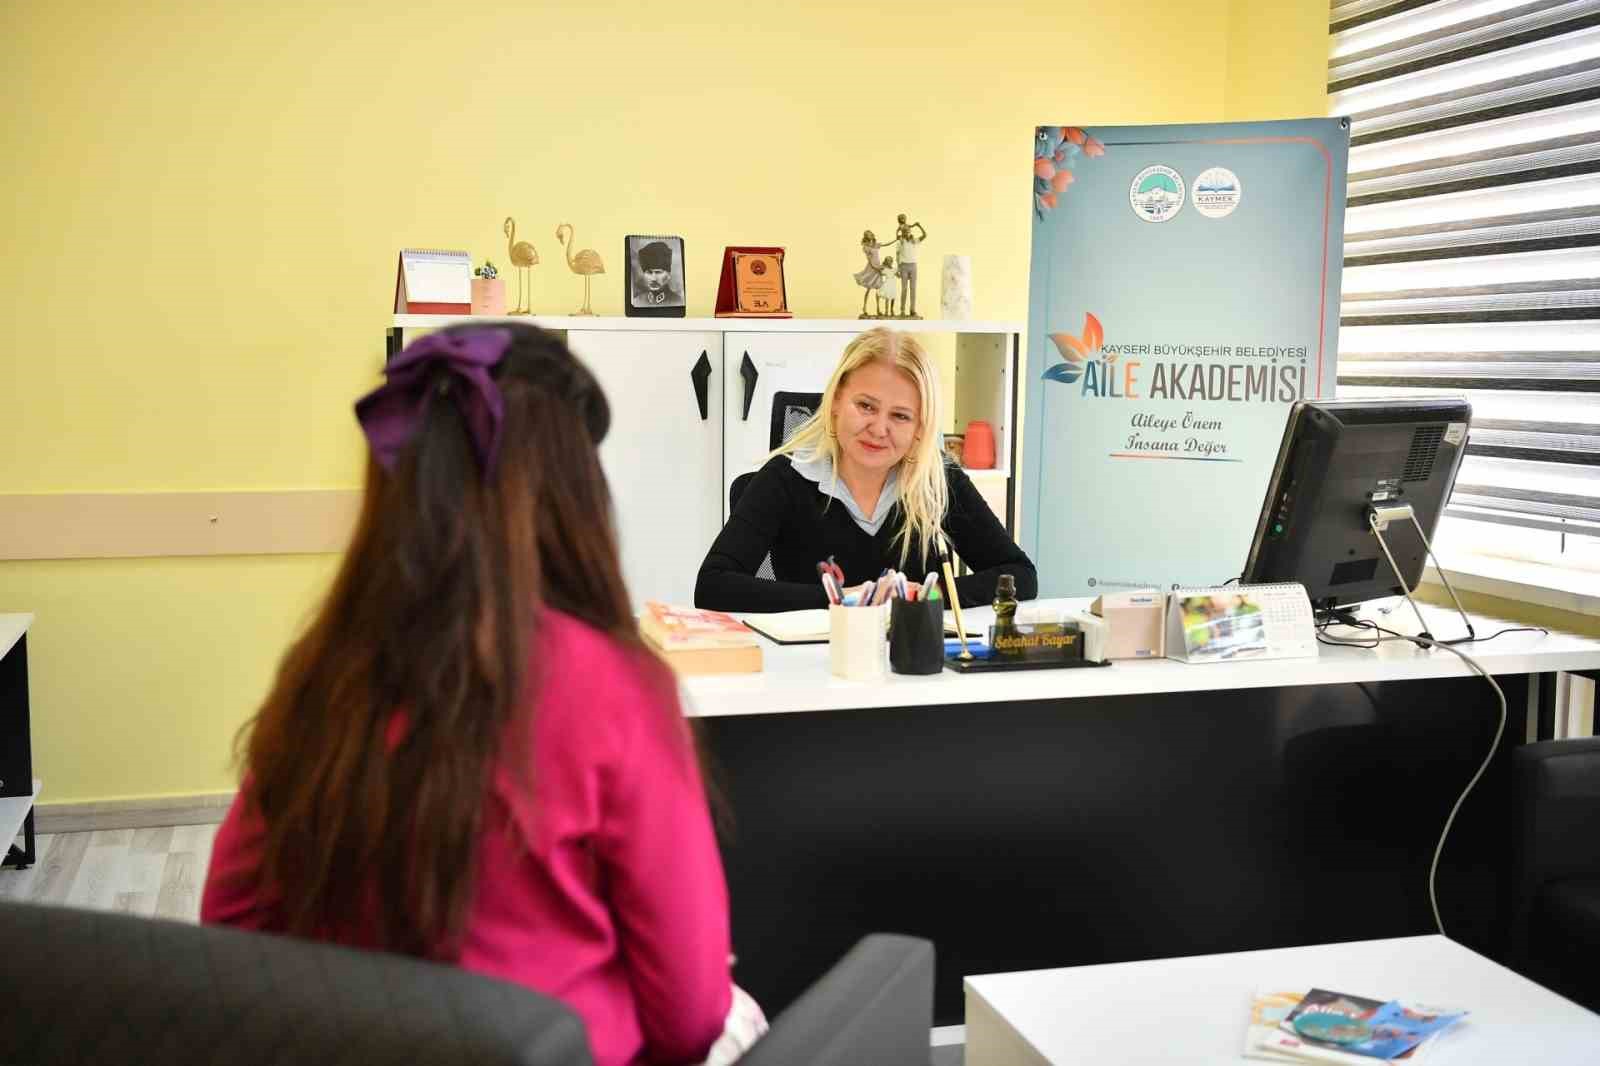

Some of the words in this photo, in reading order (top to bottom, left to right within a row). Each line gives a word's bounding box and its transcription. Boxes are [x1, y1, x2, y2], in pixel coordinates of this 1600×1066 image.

[1101, 344, 1150, 354] KAYSERİ
[1154, 344, 1232, 358] BÜYÜKŞEHİR
[1235, 346, 1307, 358] BELEDİYESİ
[1081, 354, 1141, 398] AİLE
[1149, 358, 1307, 402] AKADEMİSİ
[1130, 413, 1177, 432] Aileye
[1182, 410, 1223, 430] Önem
[1125, 432, 1179, 451] İnsana
[1183, 438, 1228, 457] Değer
